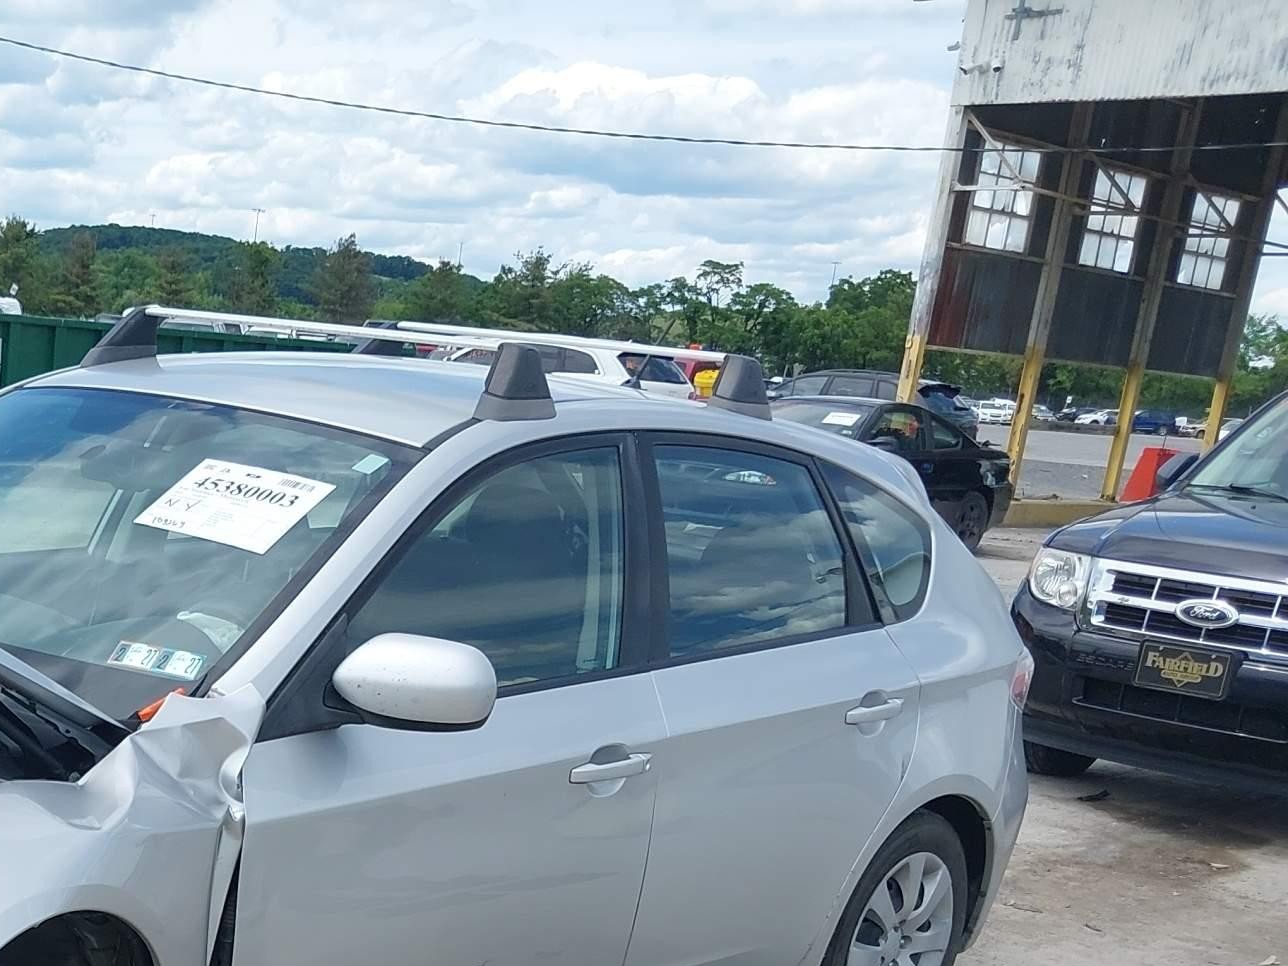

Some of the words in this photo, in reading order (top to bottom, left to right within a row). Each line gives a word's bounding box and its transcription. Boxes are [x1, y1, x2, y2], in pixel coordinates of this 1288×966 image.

[194, 476, 300, 508] 45380003
[1188, 605, 1219, 622] Ford
[114, 647, 126, 661] 2
[156, 654, 169, 669] 2
